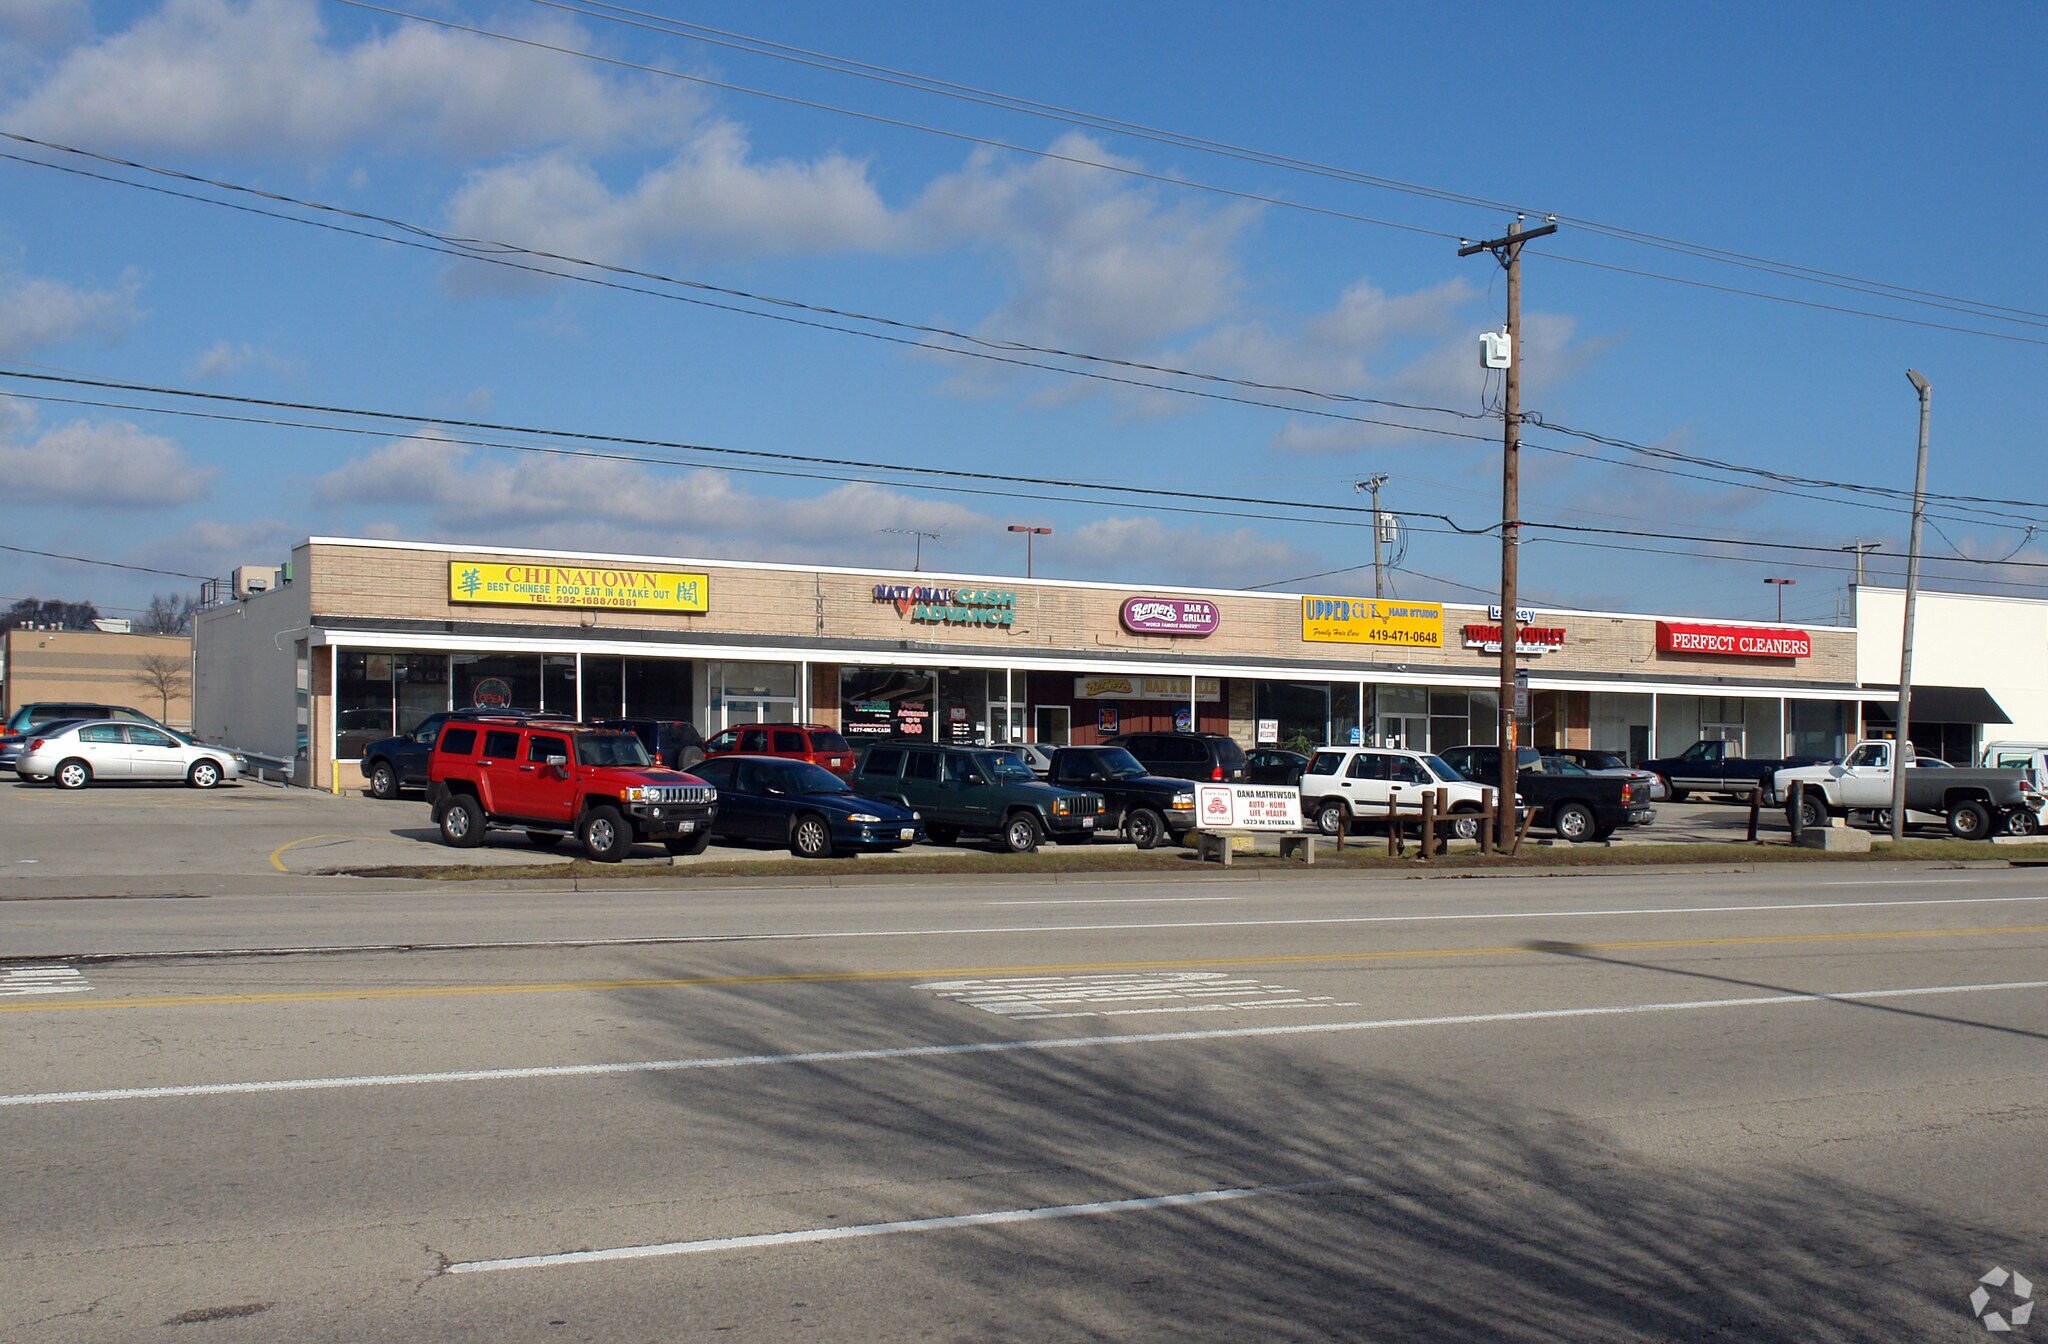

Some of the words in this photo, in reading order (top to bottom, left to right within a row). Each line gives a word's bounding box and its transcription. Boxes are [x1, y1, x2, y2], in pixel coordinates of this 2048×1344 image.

[505, 566, 657, 588] CHINATOWN
[487, 582, 510, 592] BEST
[513, 584, 550, 595] CHINESE
[556, 586, 580, 595] FOOD
[584, 588, 601, 597] EAT
[605, 588, 613, 597] IN
[618, 589, 624, 598] &
[627, 589, 650, 599] TAKE
[653, 590, 670, 600] OUT
[529, 594, 552, 604] TEL:
[876, 585, 951, 601] NATIONAL
[957, 589, 1016, 605] CASH
[914, 606, 1015, 624] ADVANCE
[1184, 604, 1201, 613] BAR
[1203, 605, 1210, 614] &
[1306, 600, 1349, 621] UPPER
[1352, 603, 1377, 619] CUT
[1388, 608, 1407, 617] HAIR
[1410, 609, 1439, 619] STUDIO
[1491, 607, 1535, 621] Lkey
[1182, 614, 1211, 623] GRILLE
[1369, 629, 1437, 643] 419-471-0648
[1465, 625, 1519, 642] TOBAC
[1522, 628, 1566, 644] OUTLET
[1672, 633, 1735, 650] PERFECT
[1739, 638, 1808, 654] CLEANERS
[1180, 680, 1218, 694] GRLLE
[1237, 790, 1255, 798] DANA
[1256, 791, 1296, 799] MATHEWSON
